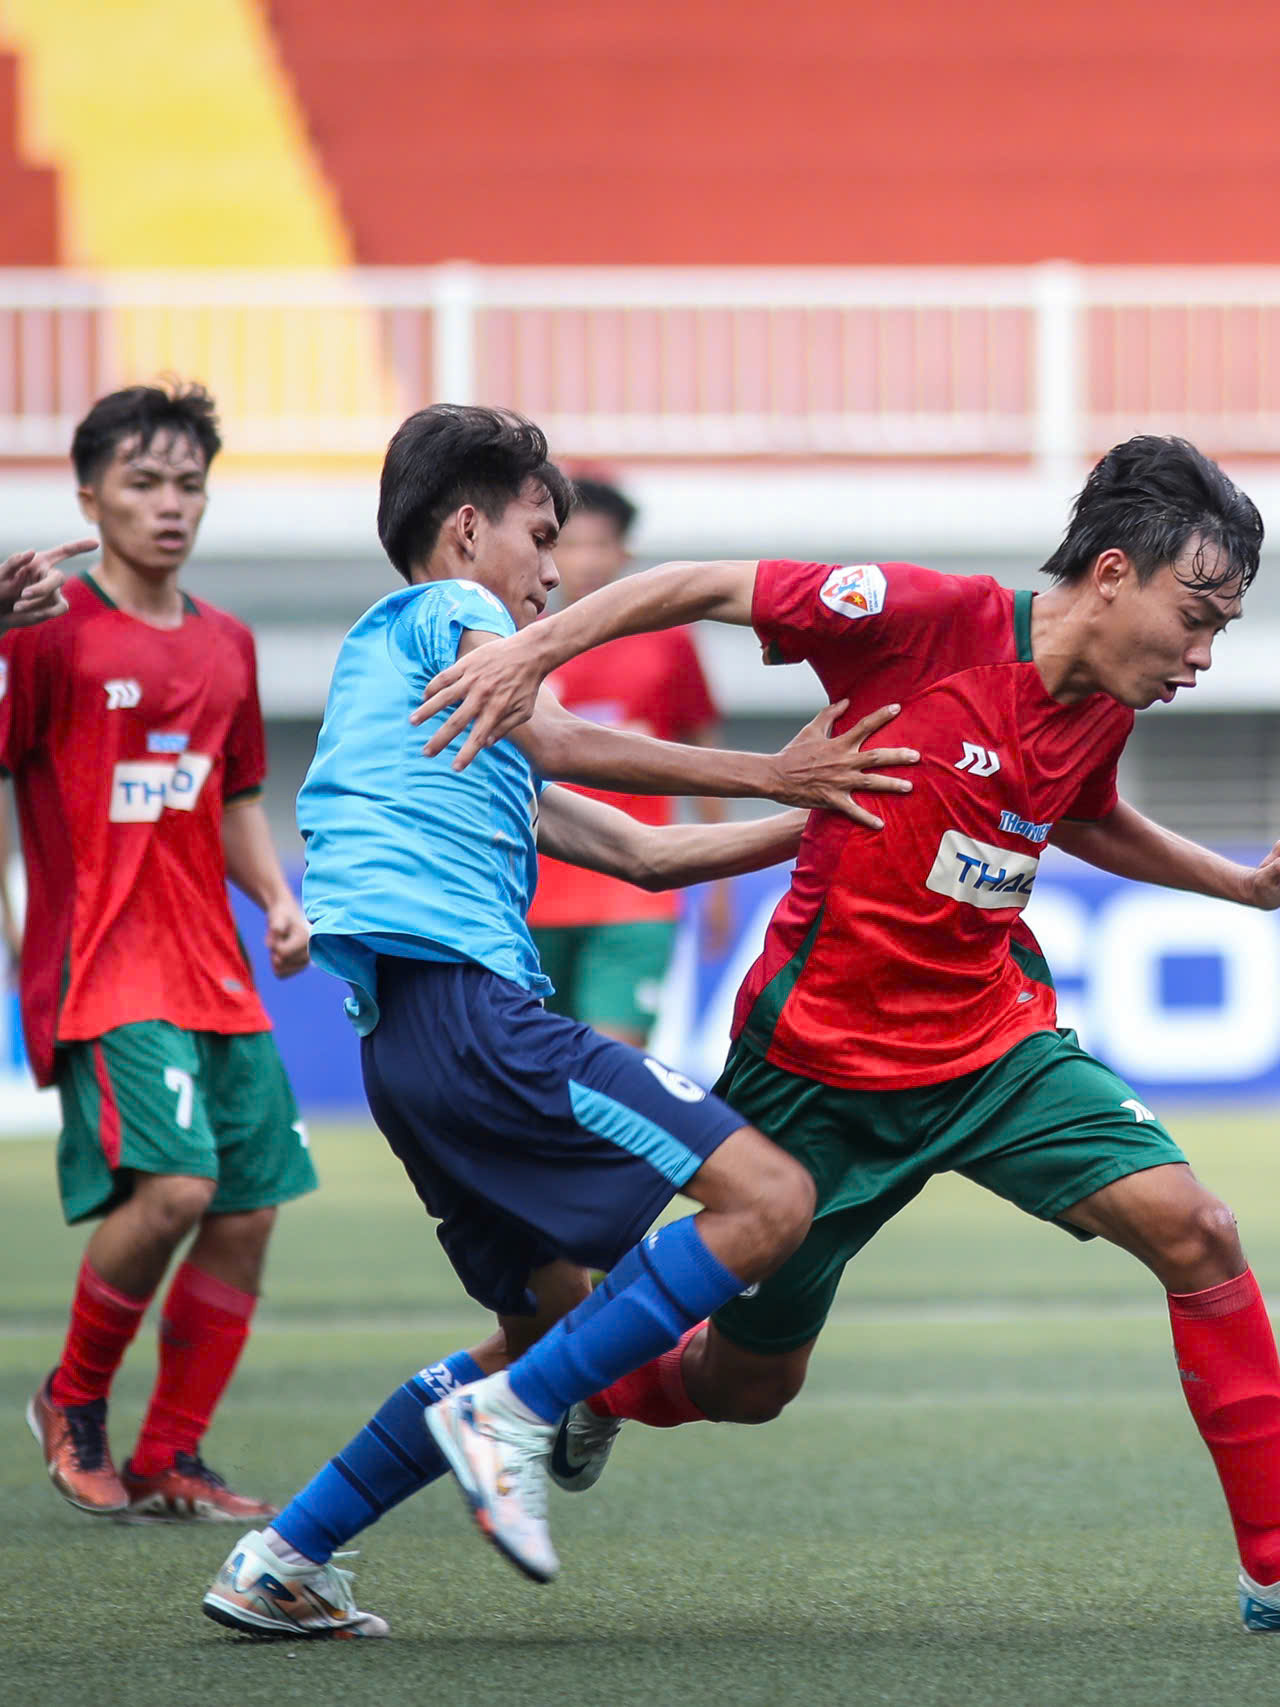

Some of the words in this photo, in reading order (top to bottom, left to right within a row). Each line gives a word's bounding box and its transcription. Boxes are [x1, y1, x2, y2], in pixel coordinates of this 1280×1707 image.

[119, 769, 193, 805] THO
[955, 851, 1037, 895] THAC
[164, 1066, 194, 1129] 7
[643, 1057, 706, 1104] 6
